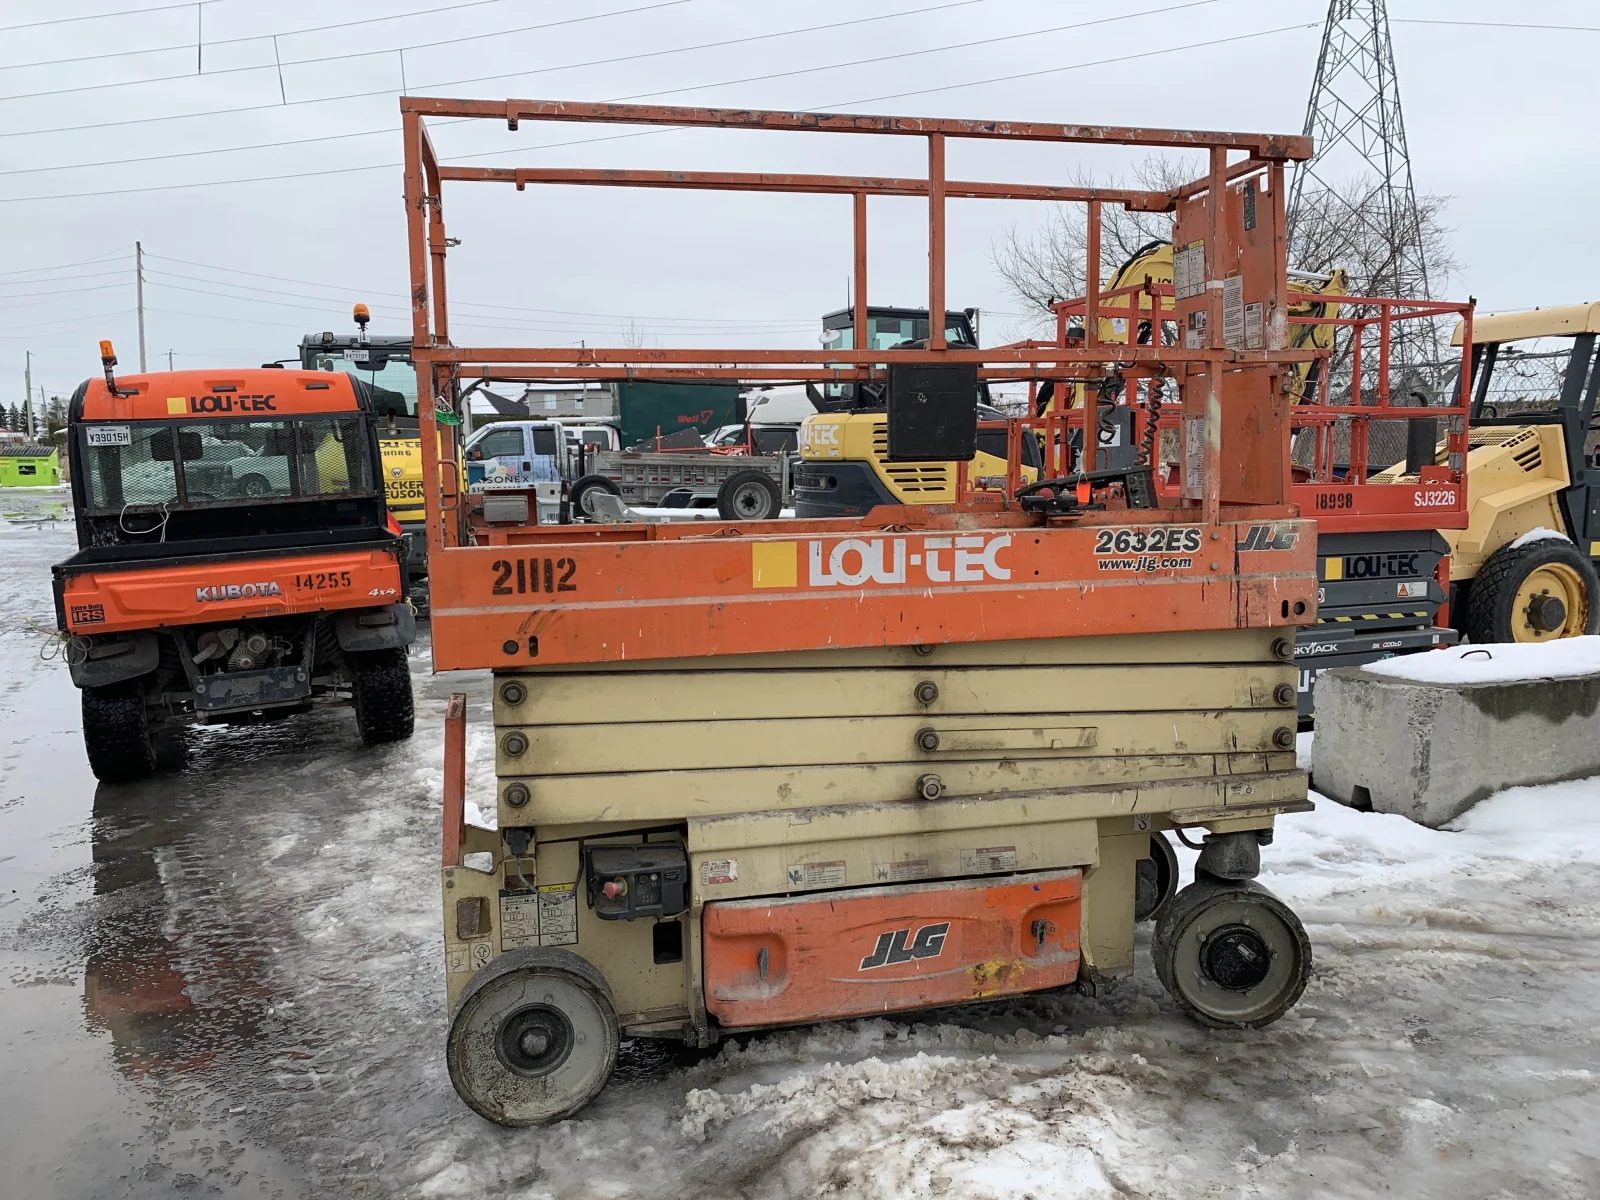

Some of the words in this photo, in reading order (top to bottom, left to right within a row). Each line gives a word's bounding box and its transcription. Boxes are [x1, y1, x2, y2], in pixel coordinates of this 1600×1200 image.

[190, 394, 277, 413] LOU-TEC
[89, 432, 129, 443] V39015H
[384, 480, 424, 490] ACKER
[385, 489, 425, 499] EUSON
[1414, 490, 1456, 507] SJ3226
[1094, 528, 1202, 554] 2632ES
[1237, 525, 1299, 552] JLG
[809, 536, 1012, 587] LOU-TEC
[1098, 556, 1192, 571] www.jlg.com
[1345, 554, 1419, 579] LOU-TEC
[295, 571, 352, 592] 14255
[492, 557, 577, 595] 21112
[196, 581, 282, 602] KUBOTA
[72, 610, 104, 622] IRS
[858, 922, 951, 972] JLG
